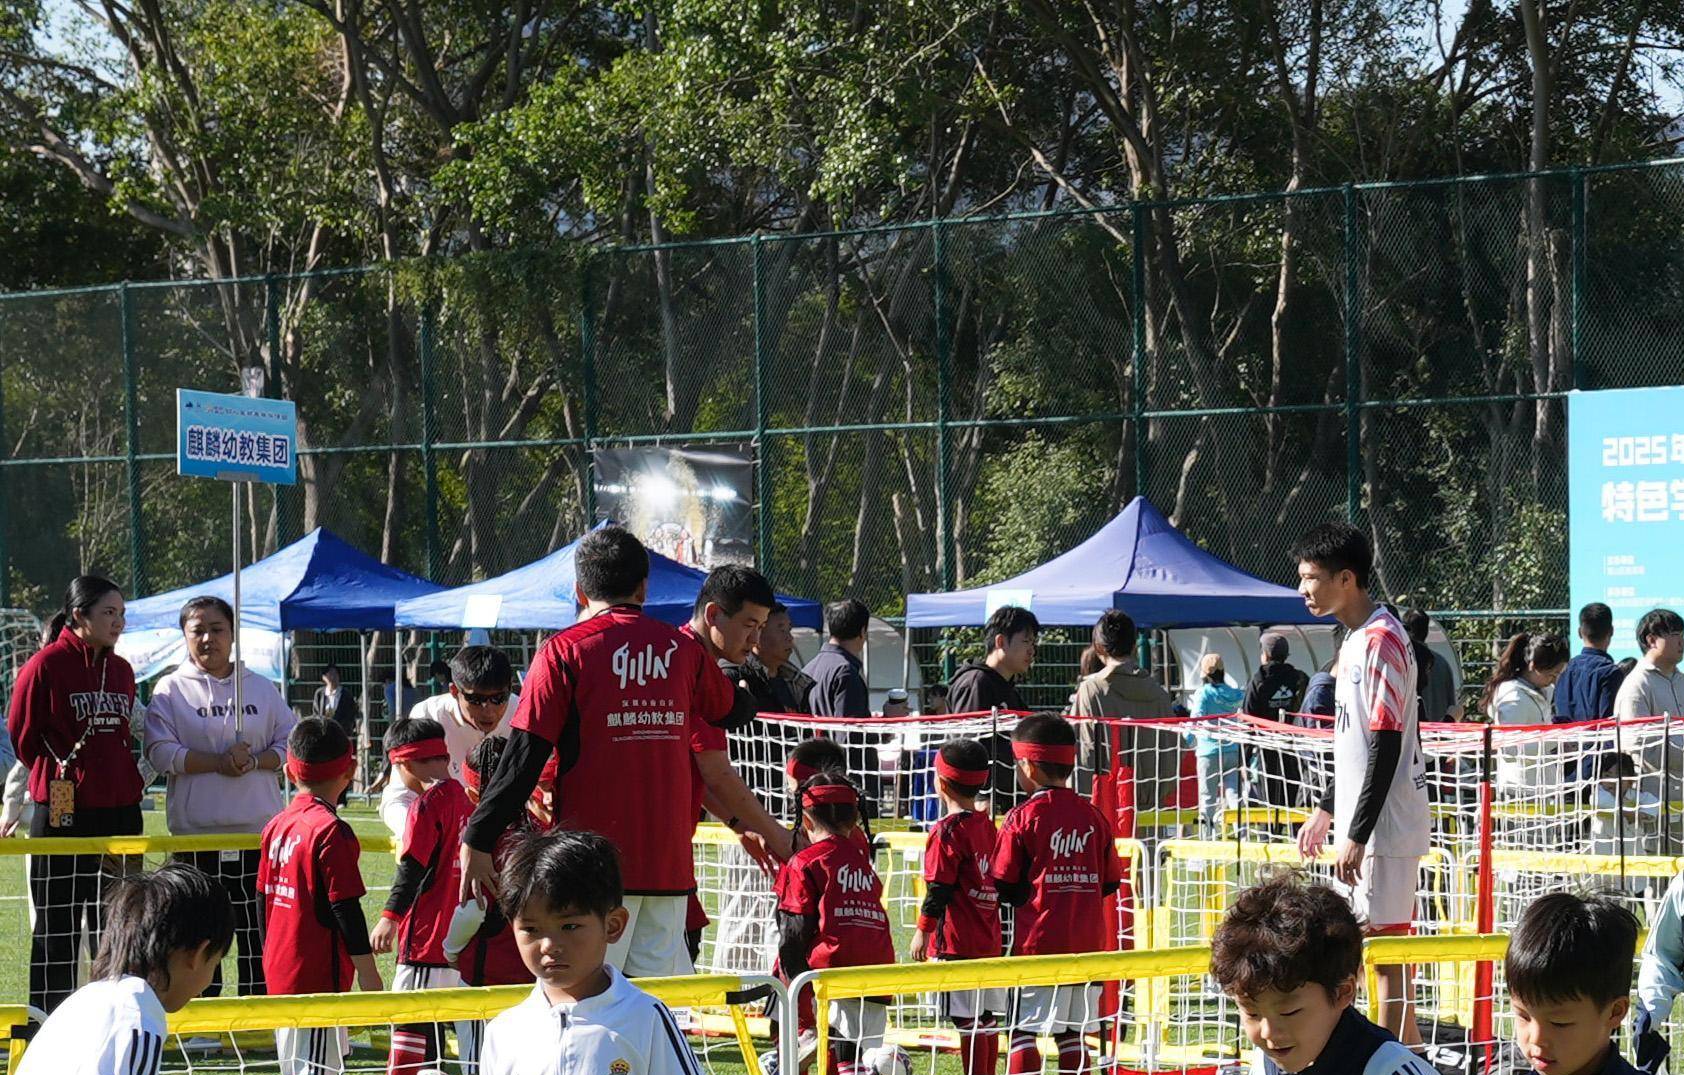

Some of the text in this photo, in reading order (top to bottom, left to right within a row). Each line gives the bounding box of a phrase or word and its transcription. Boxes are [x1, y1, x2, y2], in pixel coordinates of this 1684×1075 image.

[187, 426, 288, 466] 麒麟幼教集团
[606, 711, 685, 727] 麒麟幼教集团
